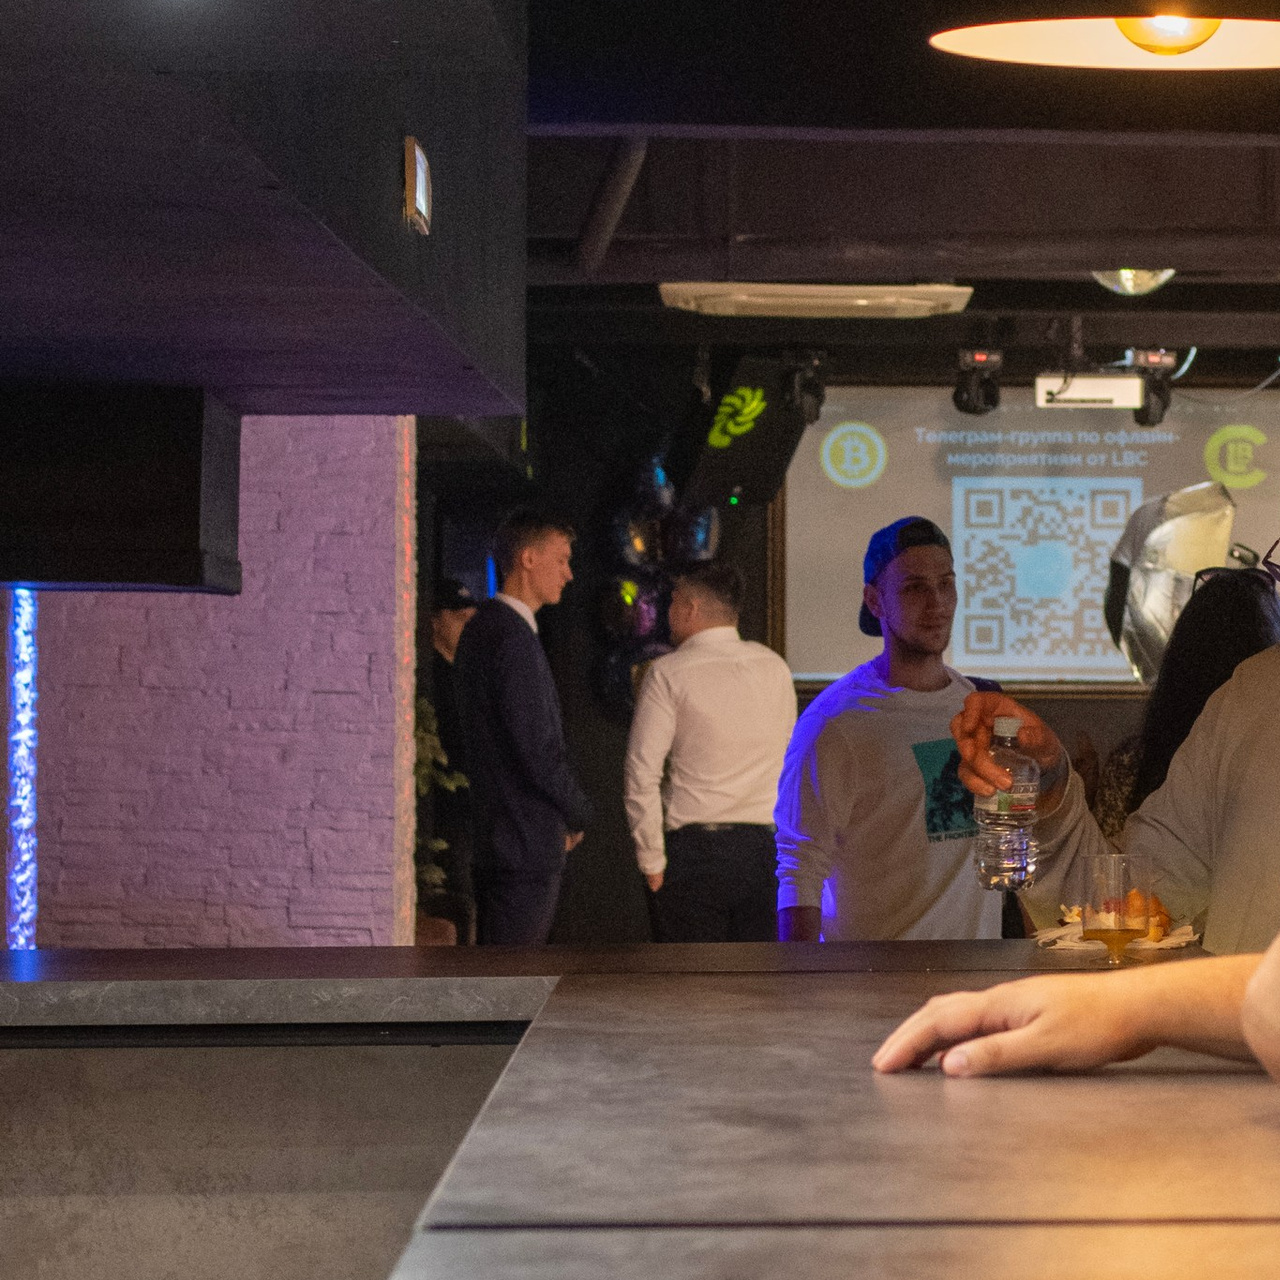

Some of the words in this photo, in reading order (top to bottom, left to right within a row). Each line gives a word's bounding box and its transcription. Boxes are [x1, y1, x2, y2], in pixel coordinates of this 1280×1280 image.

[1077, 430, 1101, 444] по
[1086, 453, 1107, 466] от
[1111, 450, 1149, 467] LBC
[928, 833, 944, 843] THE
